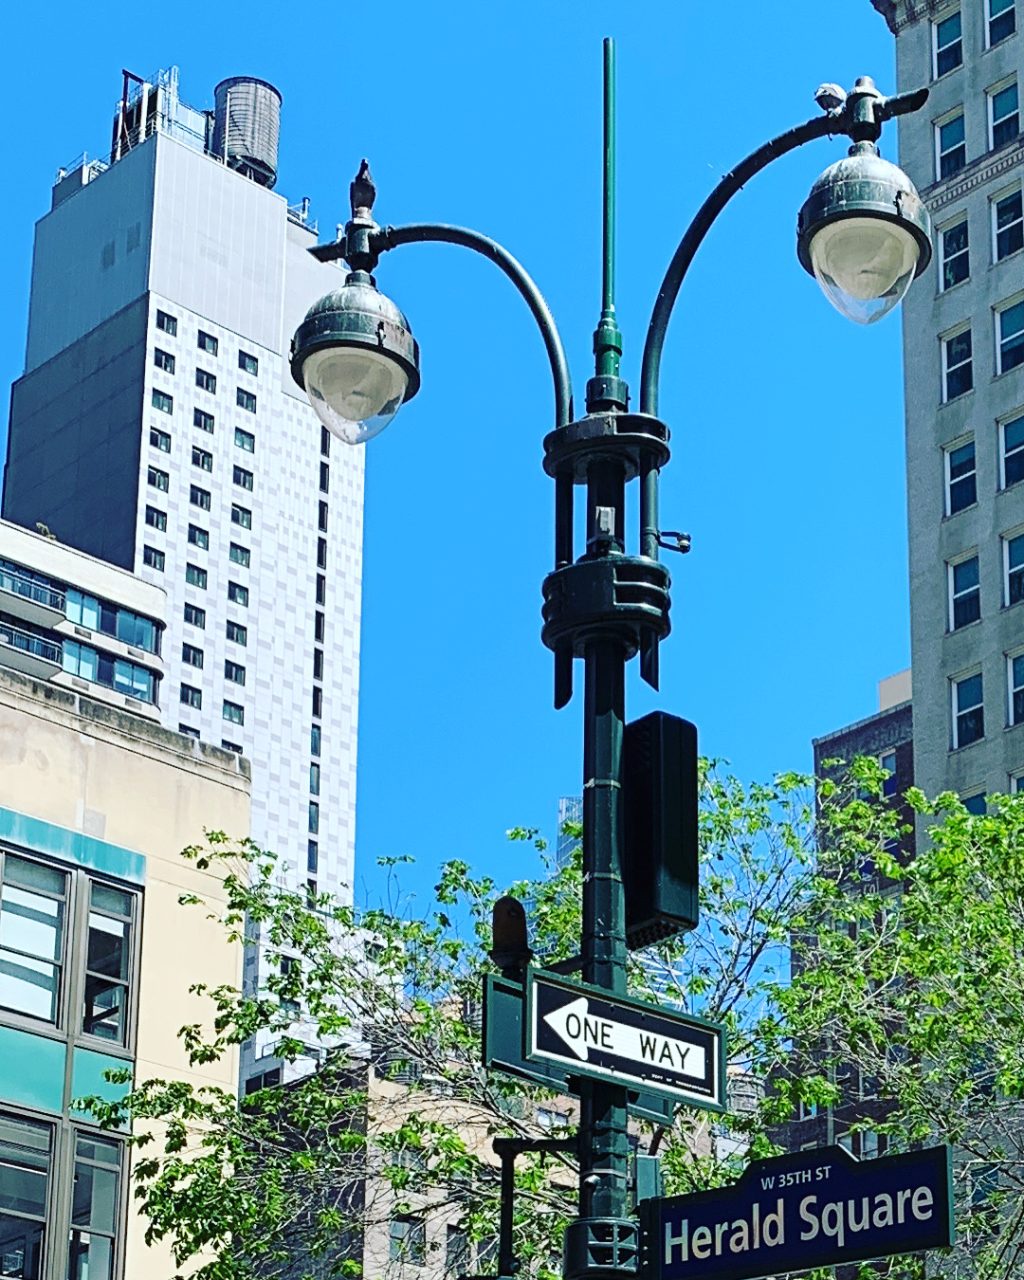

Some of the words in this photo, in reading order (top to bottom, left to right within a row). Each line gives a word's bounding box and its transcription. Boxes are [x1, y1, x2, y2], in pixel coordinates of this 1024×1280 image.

[566, 1013, 614, 1049] ONE
[640, 1033, 690, 1070] WAY
[761, 1177, 775, 1191] W
[778, 1169, 812, 1188] 35TH
[816, 1166, 832, 1181] ST
[665, 1198, 785, 1265] Herald
[799, 1185, 934, 1247] Square
